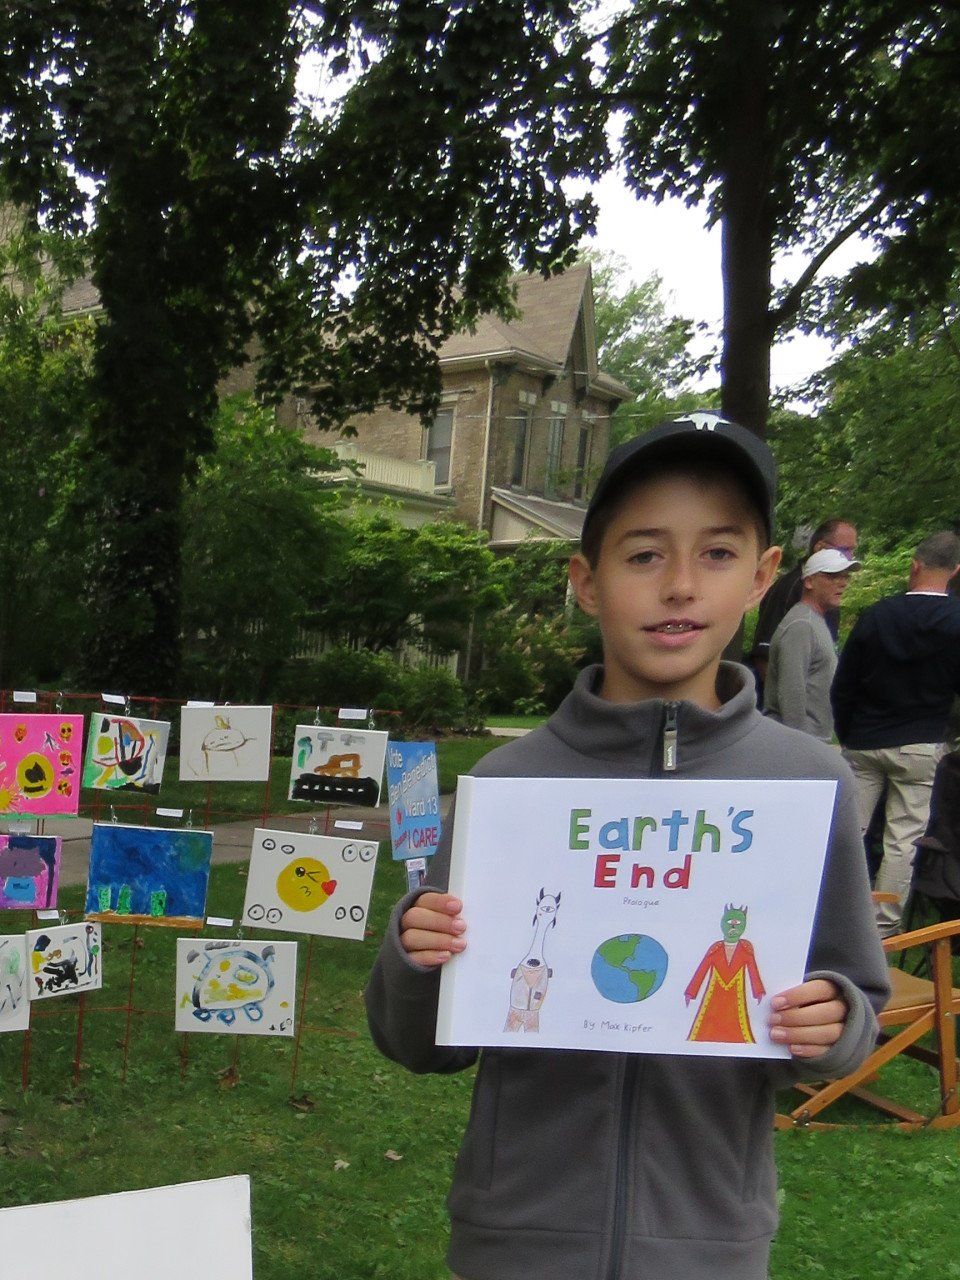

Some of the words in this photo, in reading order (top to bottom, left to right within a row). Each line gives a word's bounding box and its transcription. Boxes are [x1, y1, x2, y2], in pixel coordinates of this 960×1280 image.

[404, 798, 425, 816] Ward
[427, 796, 438, 815] 13
[412, 827, 438, 849] CARE
[569, 806, 755, 854] Earth's
[594, 854, 693, 889] End
[623, 897, 660, 909] Prologue
[583, 1020, 595, 1031] By
[601, 1020, 620, 1030] Max
